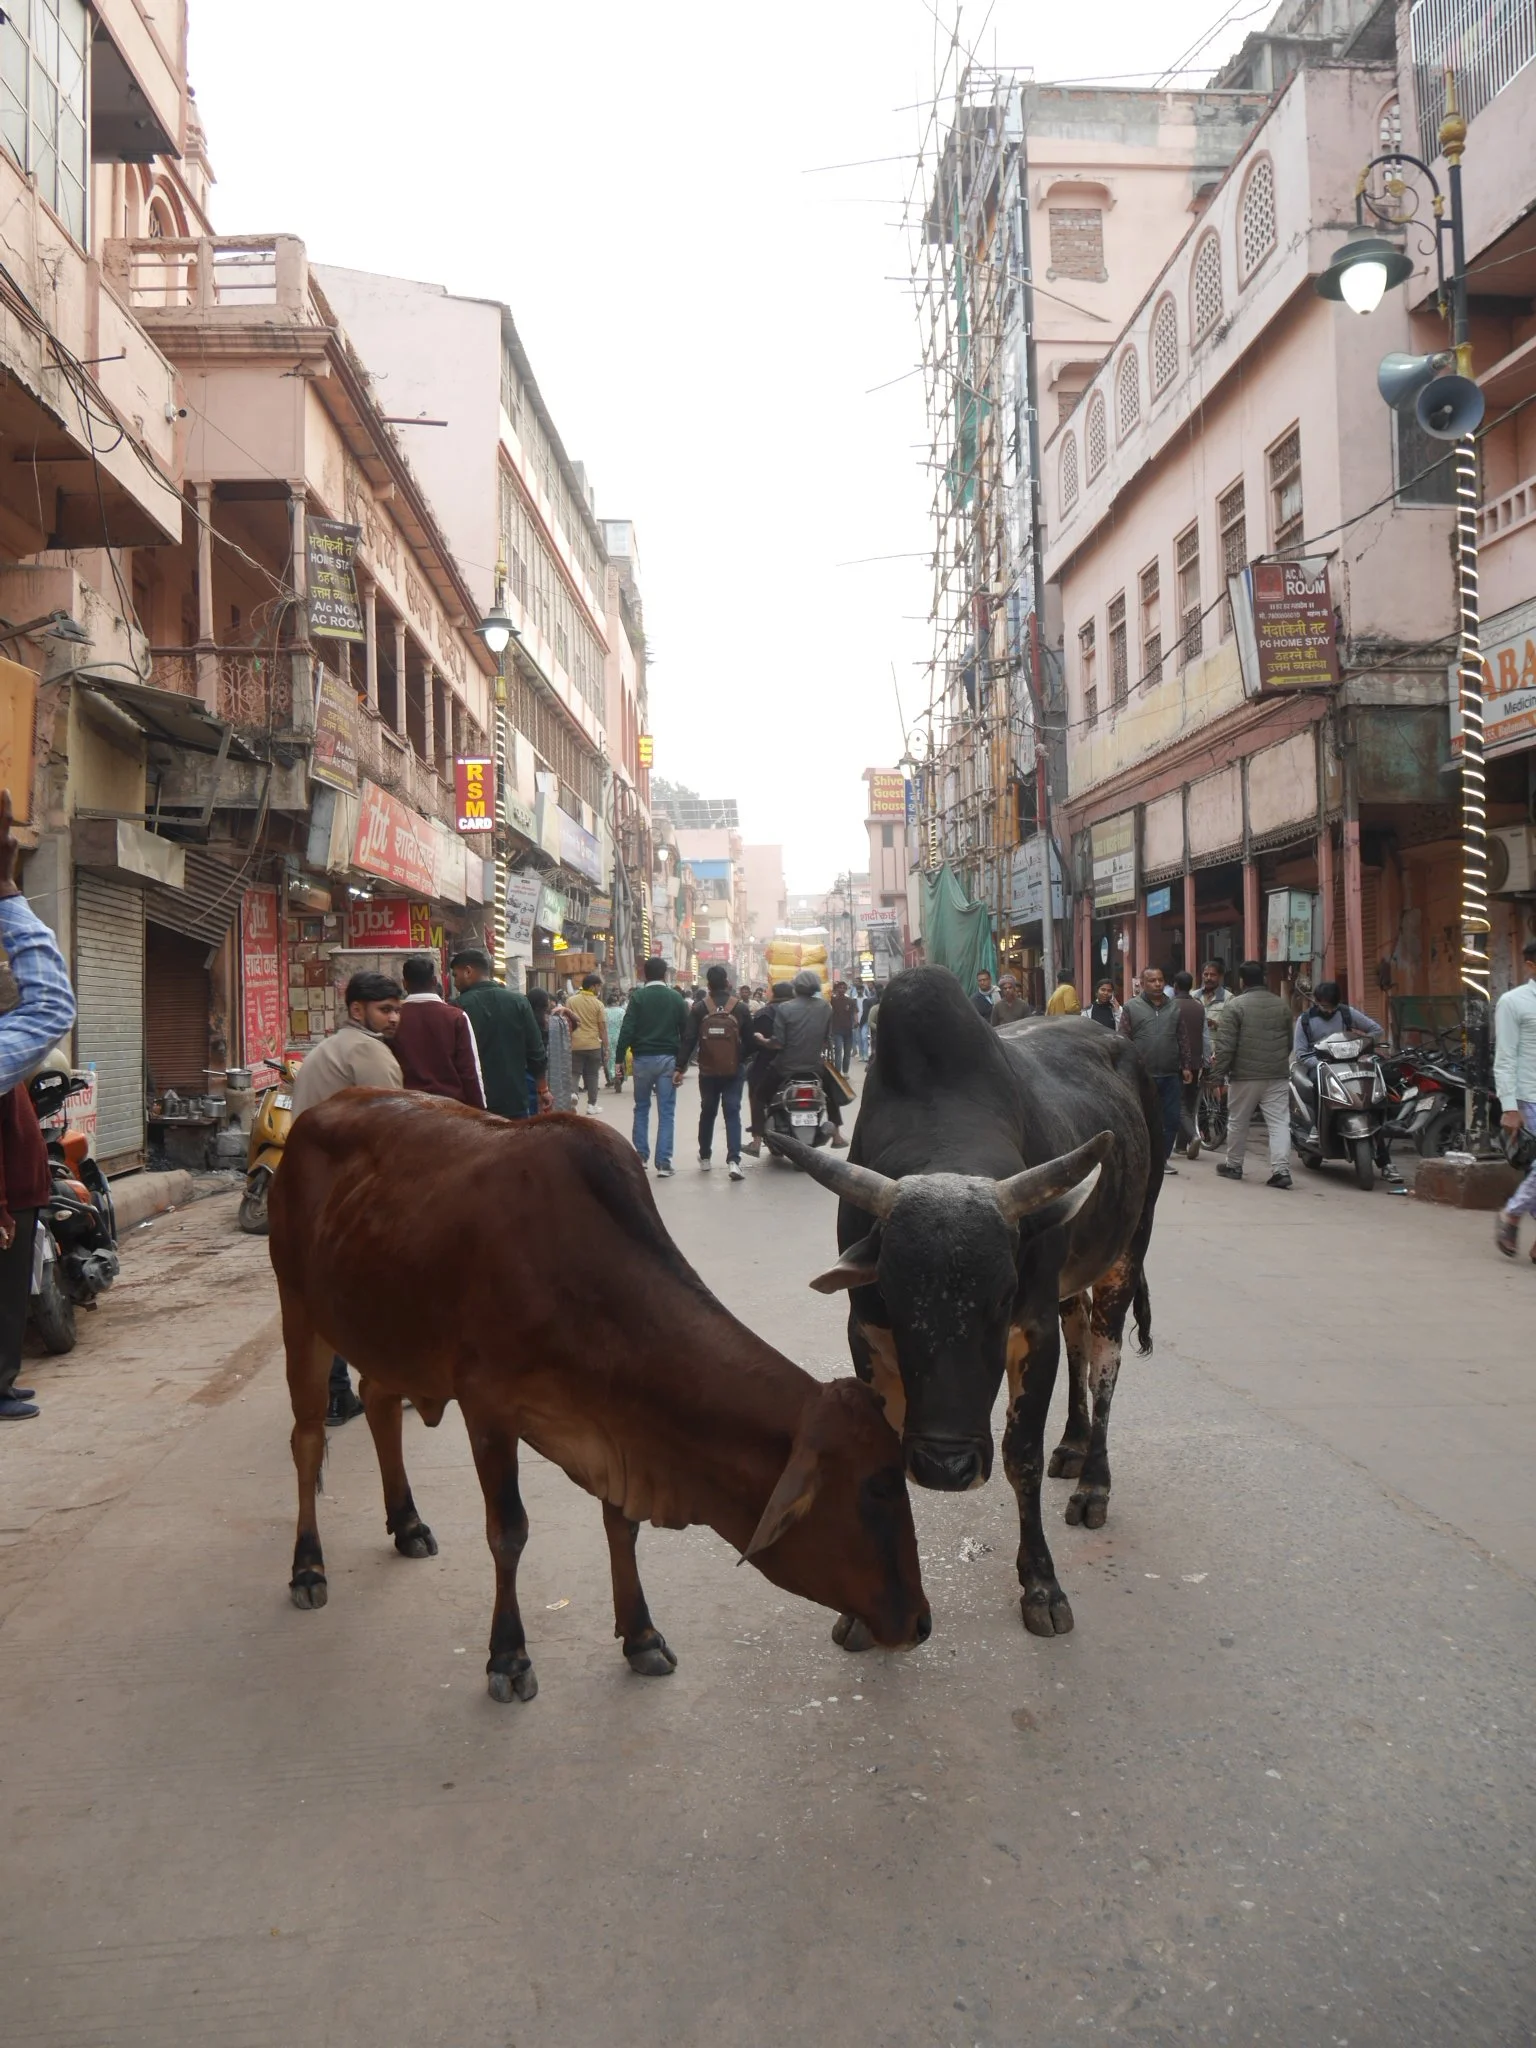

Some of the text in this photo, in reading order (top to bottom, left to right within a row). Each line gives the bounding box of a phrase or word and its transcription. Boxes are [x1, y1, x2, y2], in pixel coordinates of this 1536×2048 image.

[1286, 580, 1326, 596] ROOM
[310, 613, 327, 625] AC
[1262, 619, 1327, 637] मंदाकिनी तट
[1260, 636, 1331, 648] PG HOME STAY
[1274, 647, 1318, 661] ठहरने की
[1456, 638, 1536, 713] ABA
[873, 801, 906, 811] House
[359, 792, 391, 864] jbt
[458, 818, 493, 830] CARD
[349, 902, 395, 938] jbt
